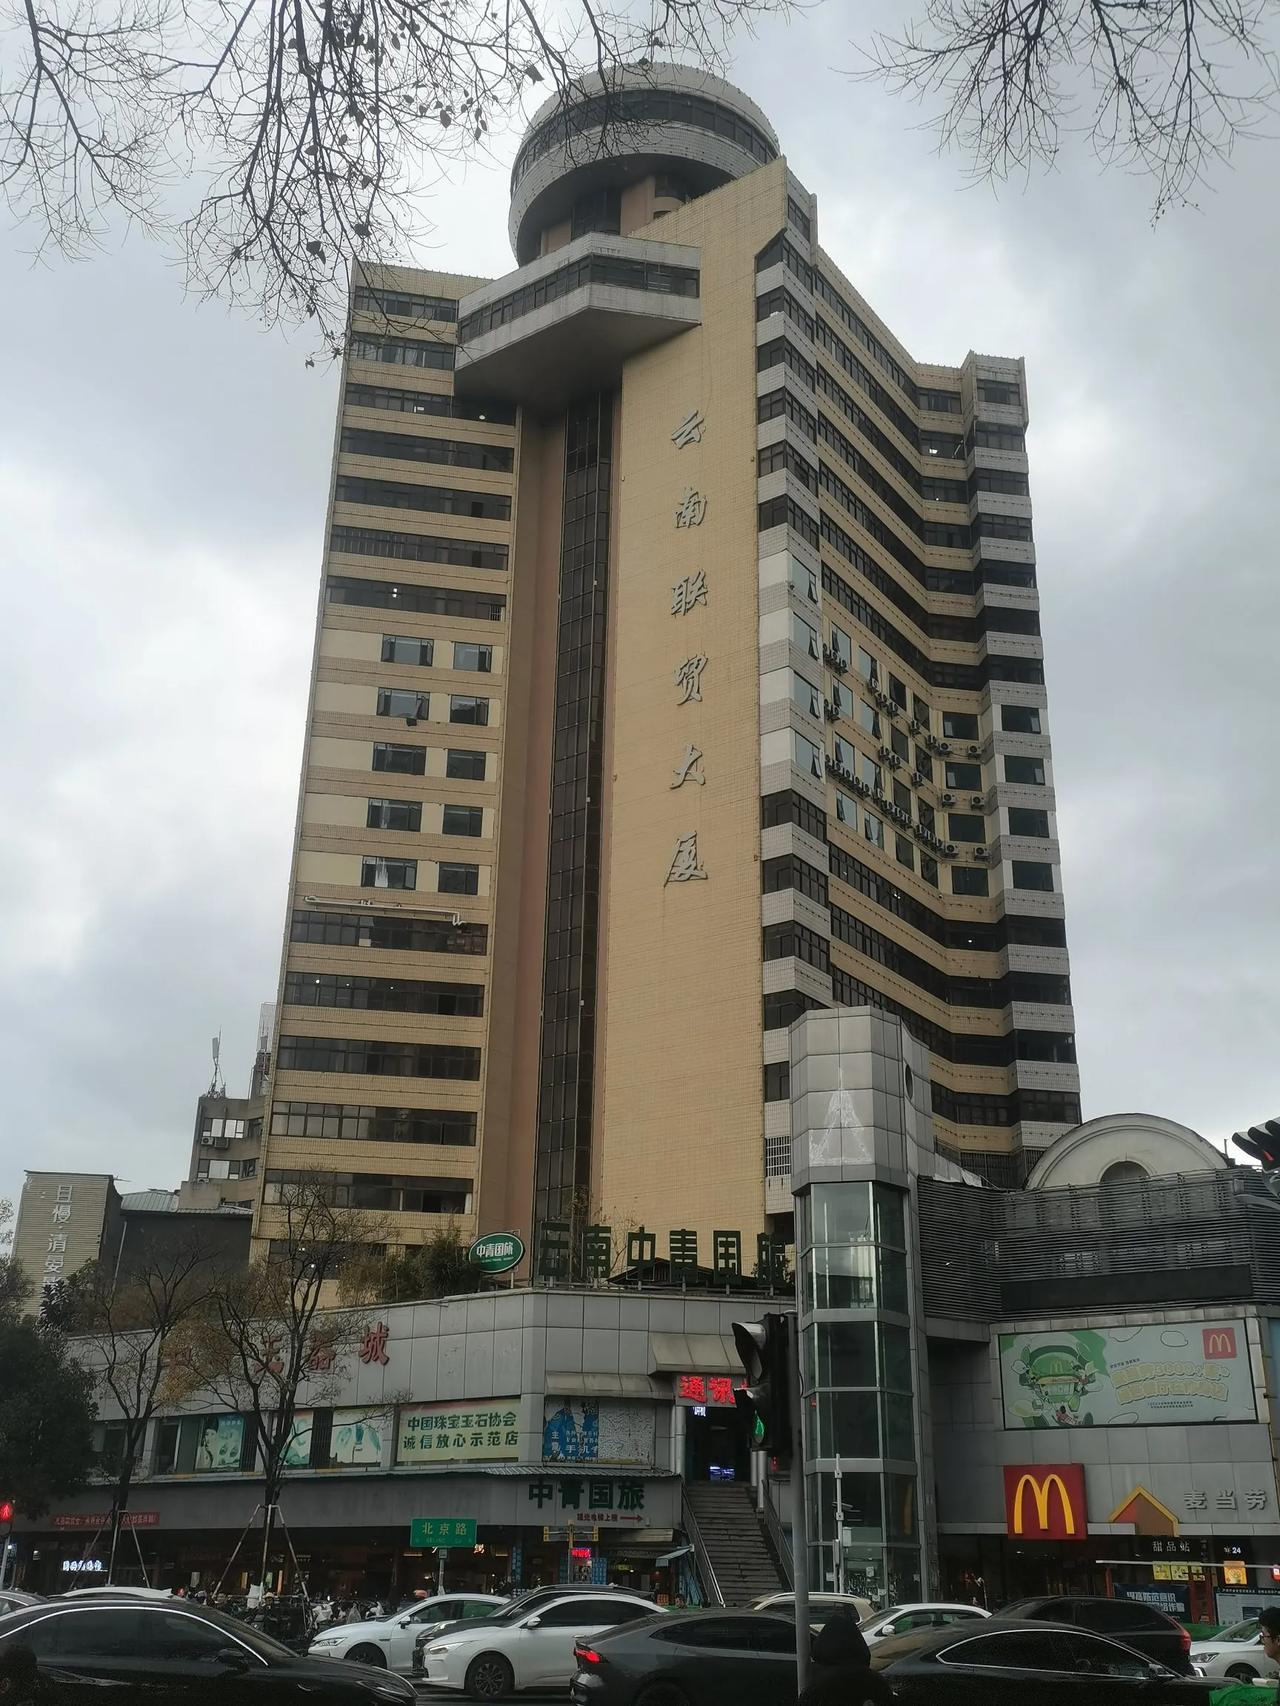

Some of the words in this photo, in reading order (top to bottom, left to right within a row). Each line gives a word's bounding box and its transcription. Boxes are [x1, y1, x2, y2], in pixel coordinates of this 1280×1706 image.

[663, 408, 710, 888] 云南联贸大厦
[476, 1241, 514, 1258] 中青国旅
[679, 1375, 748, 1404] 通讯
[408, 1412, 517, 1431] 中国珠宝玉石协会
[403, 1431, 518, 1450] 诚信放心示范店
[528, 1480, 645, 1510] 中青国旅
[1183, 1489, 1267, 1510] 麦当劳
[421, 1521, 467, 1536] 北京路
[1152, 1540, 1190, 1552] 甜品站
